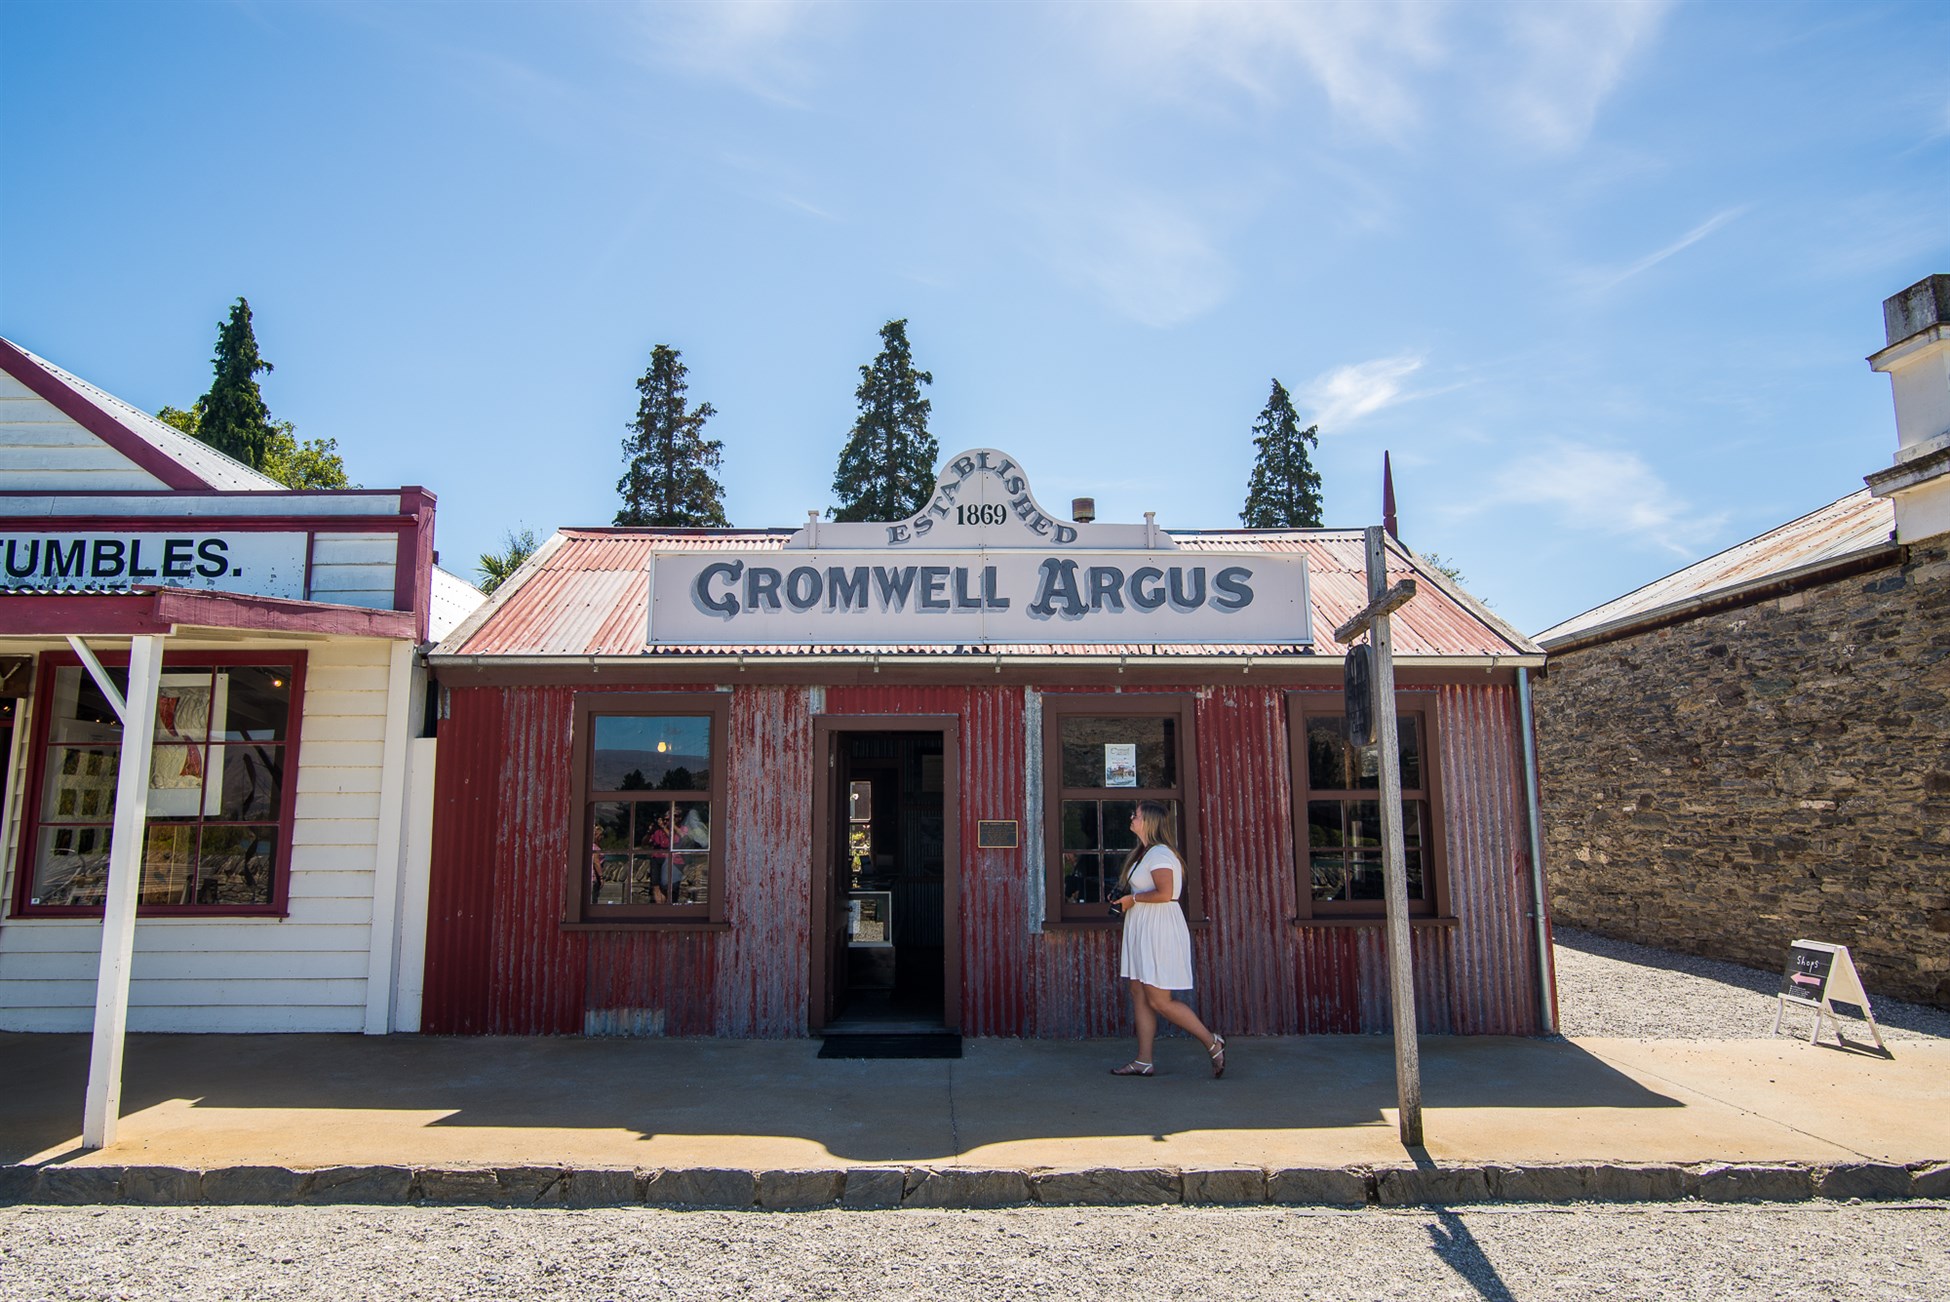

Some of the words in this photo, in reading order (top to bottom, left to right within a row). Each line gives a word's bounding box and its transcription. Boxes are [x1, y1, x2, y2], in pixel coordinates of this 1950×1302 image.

[886, 451, 1078, 545] ESTABLISHED
[956, 503, 1006, 525] 1869
[0, 538, 242, 577] UMBLES.
[690, 559, 1010, 622] CROMWELL
[1026, 558, 1254, 621] ARGUS
